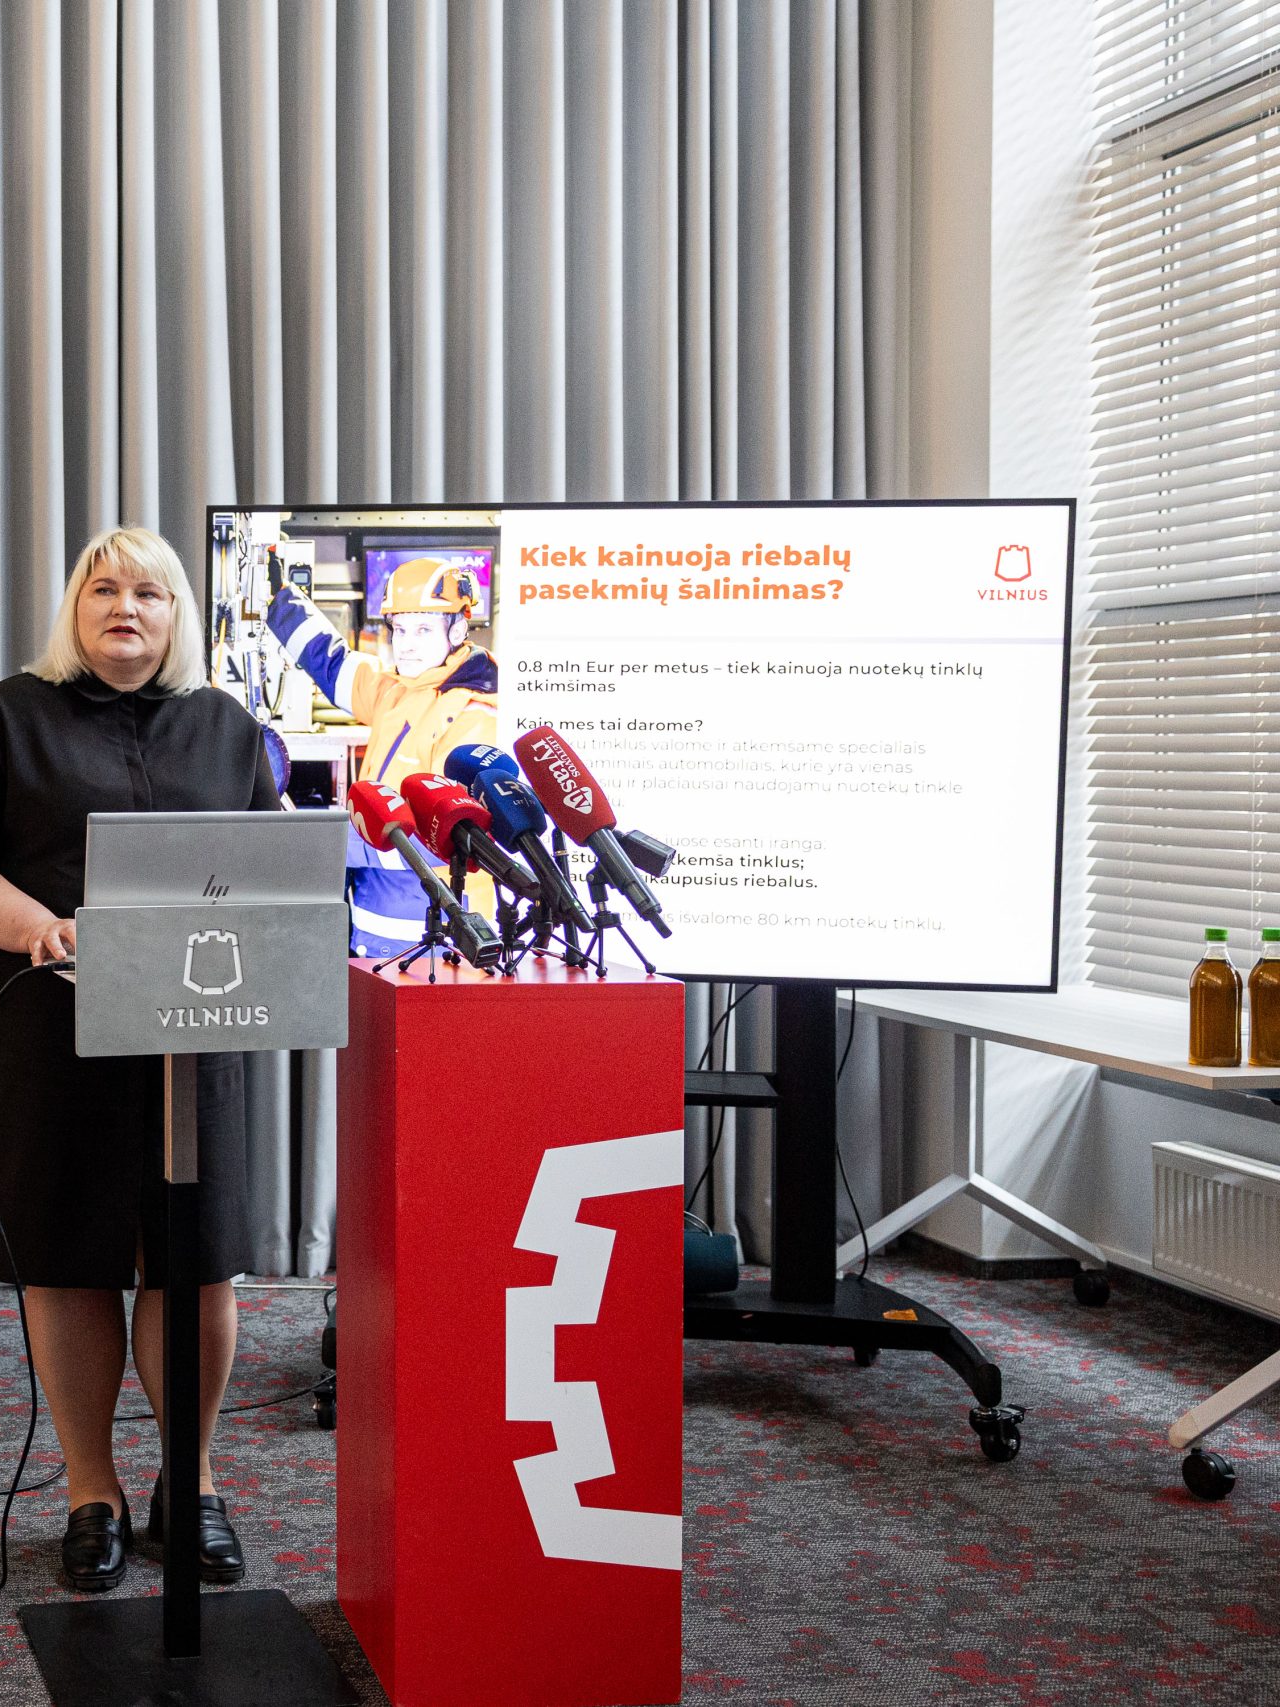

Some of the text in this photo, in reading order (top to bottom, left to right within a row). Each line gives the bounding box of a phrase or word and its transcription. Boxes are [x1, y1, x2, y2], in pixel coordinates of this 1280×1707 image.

[520, 543, 851, 572] Kiek kainuoja riebalų
[519, 577, 844, 605] pasekmių šalinimas?
[977, 589, 1048, 601] VILNIUS
[517, 660, 543, 673] 0.8
[548, 660, 581, 673] mln
[586, 661, 615, 673] Eur
[620, 663, 648, 676] per
[654, 662, 709, 674] metus
[727, 661, 760, 674] tiek
[767, 661, 842, 677] kainuoja
[849, 663, 923, 678] nuotekų
[930, 663, 983, 679] tinklų
[517, 679, 616, 692] atkimšimas
[559, 720, 594, 730] mes
[600, 717, 621, 730] tai
[626, 718, 704, 731] darome?
[591, 738, 647, 751] tinklus
[650, 739, 713, 751] valome
[717, 740, 728, 751] ir
[838, 740, 927, 756] specialiais
[545, 735, 580, 778] LIETUVOS
[531, 739, 577, 793] rytas
[780, 759, 823, 773] kurie
[827, 762, 853, 776] yra
[858, 760, 913, 773] vienas
[914, 780, 963, 795] tinkle
[713, 837, 763, 848] esanti
[740, 854, 805, 870] tinklus;
[202, 874, 229, 905] hp
[743, 874, 818, 888] riebalus.
[757, 913, 779, 926] 80
[784, 913, 811, 926] km
[156, 1005, 270, 1028] VILNIUS
